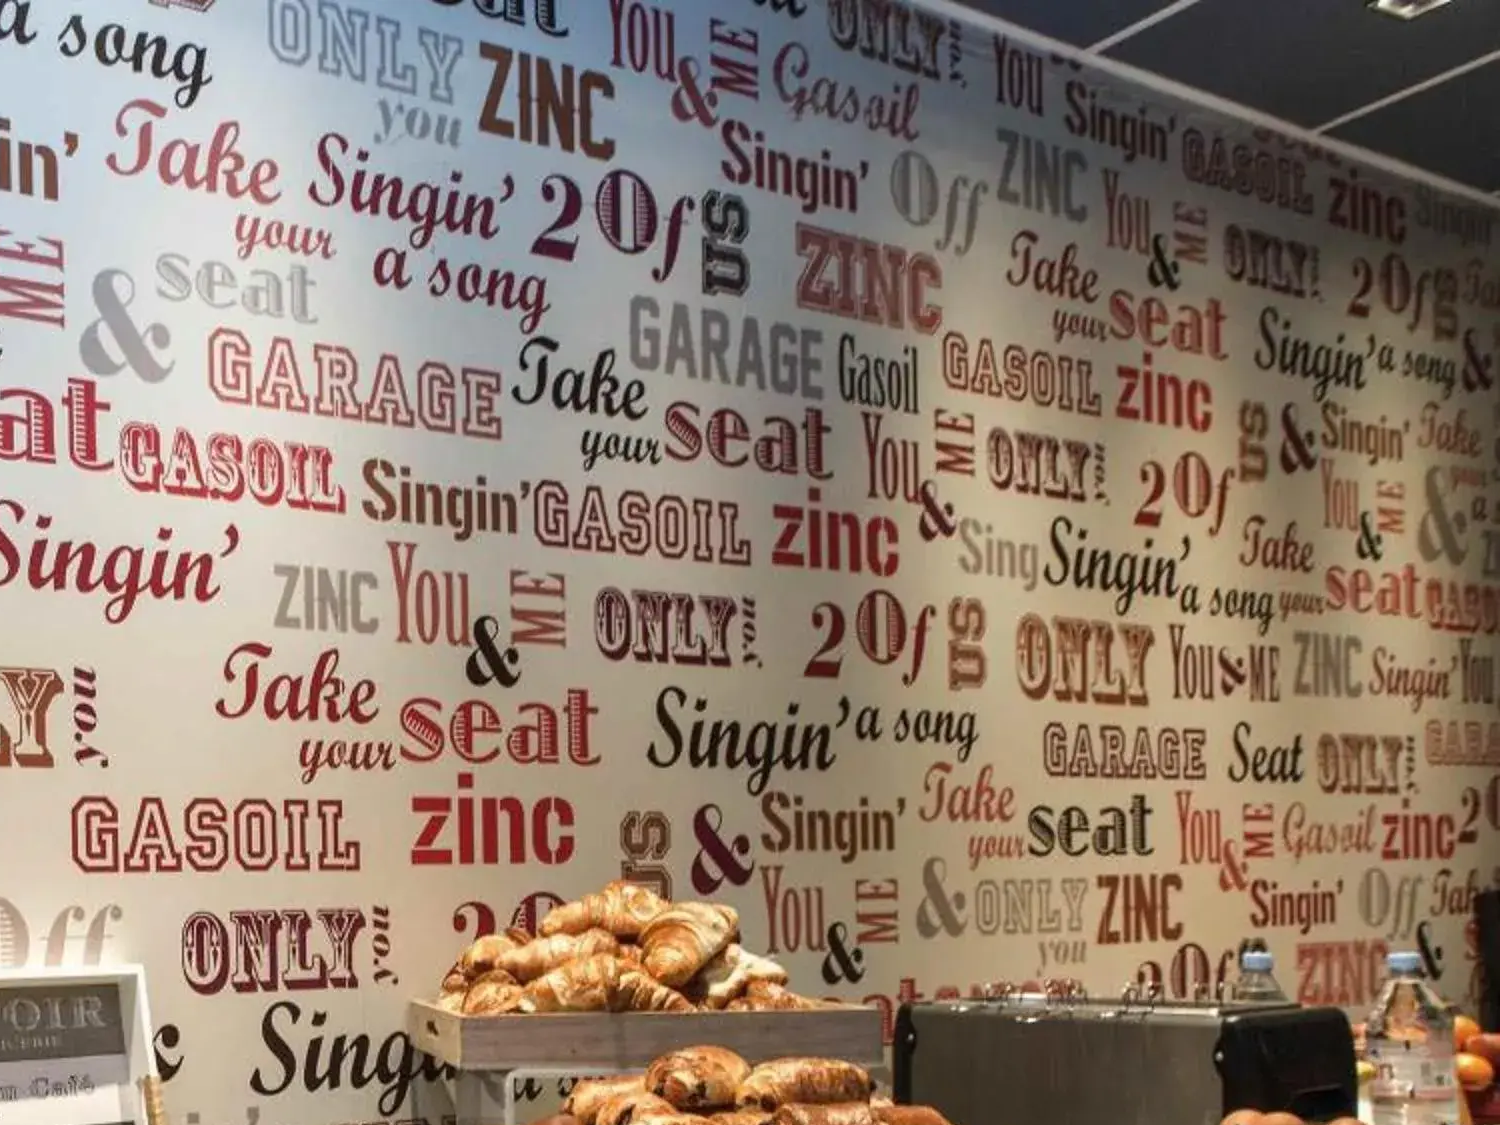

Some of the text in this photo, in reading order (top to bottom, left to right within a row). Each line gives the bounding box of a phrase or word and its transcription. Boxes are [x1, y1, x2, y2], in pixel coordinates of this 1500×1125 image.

[58, 15, 212, 108] song
[268, 0, 465, 149] ONLY you
[670, 17, 758, 129] & ME
[827, 0, 946, 80] ONLY
[993, 33, 1044, 116] You
[478, 40, 616, 162] ZINC
[772, 41, 920, 142] Gasoil
[1064, 80, 1178, 162] Singin'
[106, 98, 337, 325] Take your seat
[308, 132, 514, 249] Singin'
[720, 118, 869, 215] Singin'
[890, 150, 989, 257] Off
[996, 127, 1089, 223] ZINC
[1327, 167, 1407, 245] zinc
[372, 242, 412, 290] a
[701, 188, 751, 298] US
[1102, 168, 1208, 291] You & ME
[428, 253, 552, 334] song
[795, 221, 943, 337] ZINC
[1006, 229, 1229, 361] Take seat
[78, 268, 176, 384] &
[629, 294, 824, 401] GARAGE
[1254, 306, 1457, 402] Singin' song
[1462, 327, 1495, 393] &
[207, 327, 502, 441] GARAGE
[512, 336, 834, 481] Take your seat
[838, 332, 920, 415] Gasoil
[942, 331, 1102, 418] GASOIL
[1115, 351, 1213, 433] zinc
[118, 420, 347, 515] GASOIL
[860, 407, 976, 542] You & ME
[986, 425, 1092, 503] ONLY
[1279, 401, 1318, 476] &
[1321, 400, 1410, 467] Singin'
[1417, 401, 1483, 458] Take
[362, 457, 530, 541] Singin'
[533, 479, 752, 567] GASOIL
[771, 486, 900, 577] zinc
[1355, 510, 1383, 562] &
[1417, 465, 1469, 567] &
[272, 563, 380, 635] ZINC
[958, 516, 1039, 592] Sing
[1044, 515, 1274, 637] Singin' a song
[1239, 514, 1422, 618] Take seat
[386, 540, 567, 689] You & ME
[595, 585, 738, 667] ONLY
[947, 596, 988, 692] US
[1015, 612, 1156, 706] ONLY
[1293, 630, 1363, 698] ZINC
[1369, 645, 1458, 714] Singin'
[73, 665, 109, 768] you
[216, 642, 602, 785] Take your seat
[647, 685, 980, 796] Singin' a song
[1043, 722, 1207, 780] GARAGE
[1228, 721, 1305, 784] Seat
[1317, 733, 1403, 795] ONLY
[71, 795, 361, 873] GASOIL
[411, 773, 576, 866] zinc
[691, 802, 756, 895] &
[760, 790, 906, 864] Singin'
[918, 761, 1156, 871] Take your seat
[1175, 789, 1222, 865] You
[1282, 801, 1378, 864] Gasoil
[1381, 797, 1456, 861] zinc
[760, 865, 899, 986] You & ME
[915, 856, 969, 939] &
[975, 877, 1089, 936] ONLY
[1097, 873, 1184, 945] ZINC
[1250, 879, 1344, 935] Singin'
[1358, 867, 1424, 940] Off
[181, 907, 367, 996] ONLY
[369, 904, 400, 987] you
